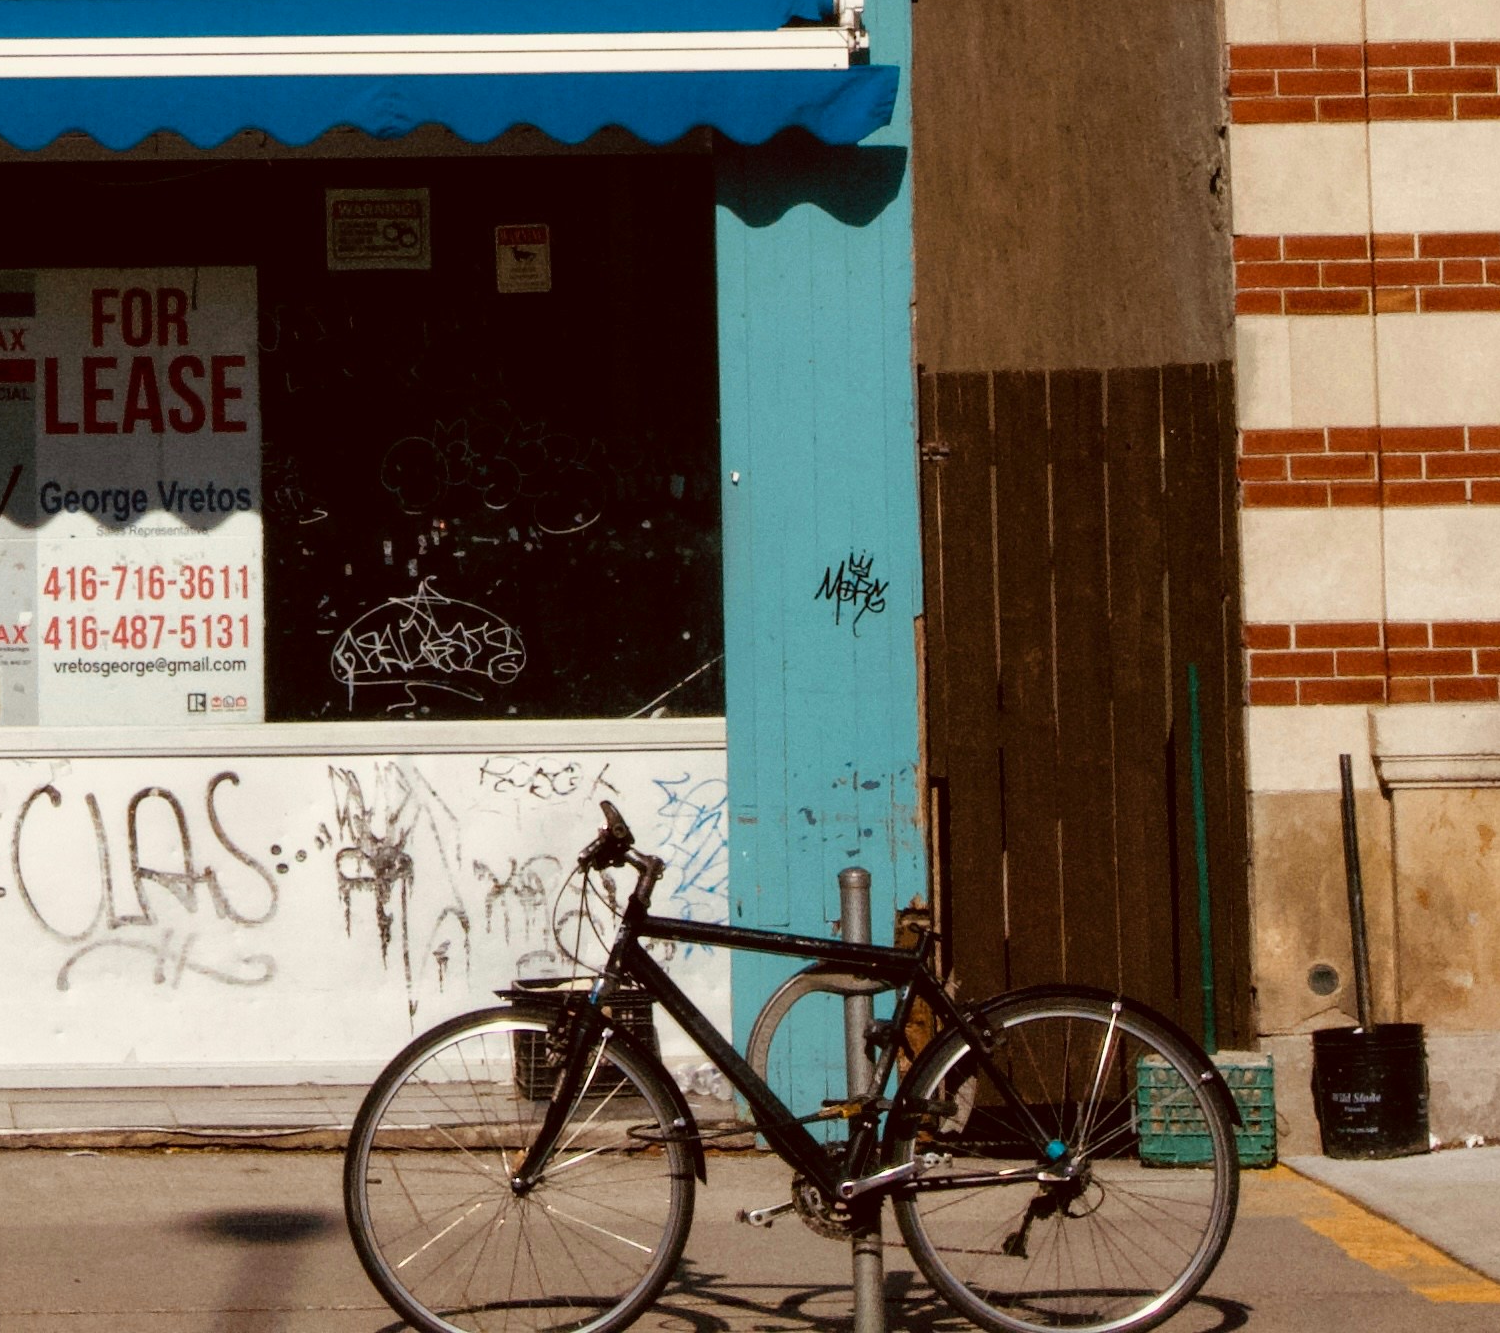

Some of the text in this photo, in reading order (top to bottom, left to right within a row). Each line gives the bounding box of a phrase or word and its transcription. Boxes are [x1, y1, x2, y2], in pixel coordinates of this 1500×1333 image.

[90, 286, 189, 348] FOR
[43, 354, 249, 435] LEASE
[38, 480, 253, 521] George Vretos
[43, 564, 250, 603] 416-716-3611
[43, 613, 250, 651] 416-487-5131
[52, 656, 247, 678] vretosgeorge@gmail.com
